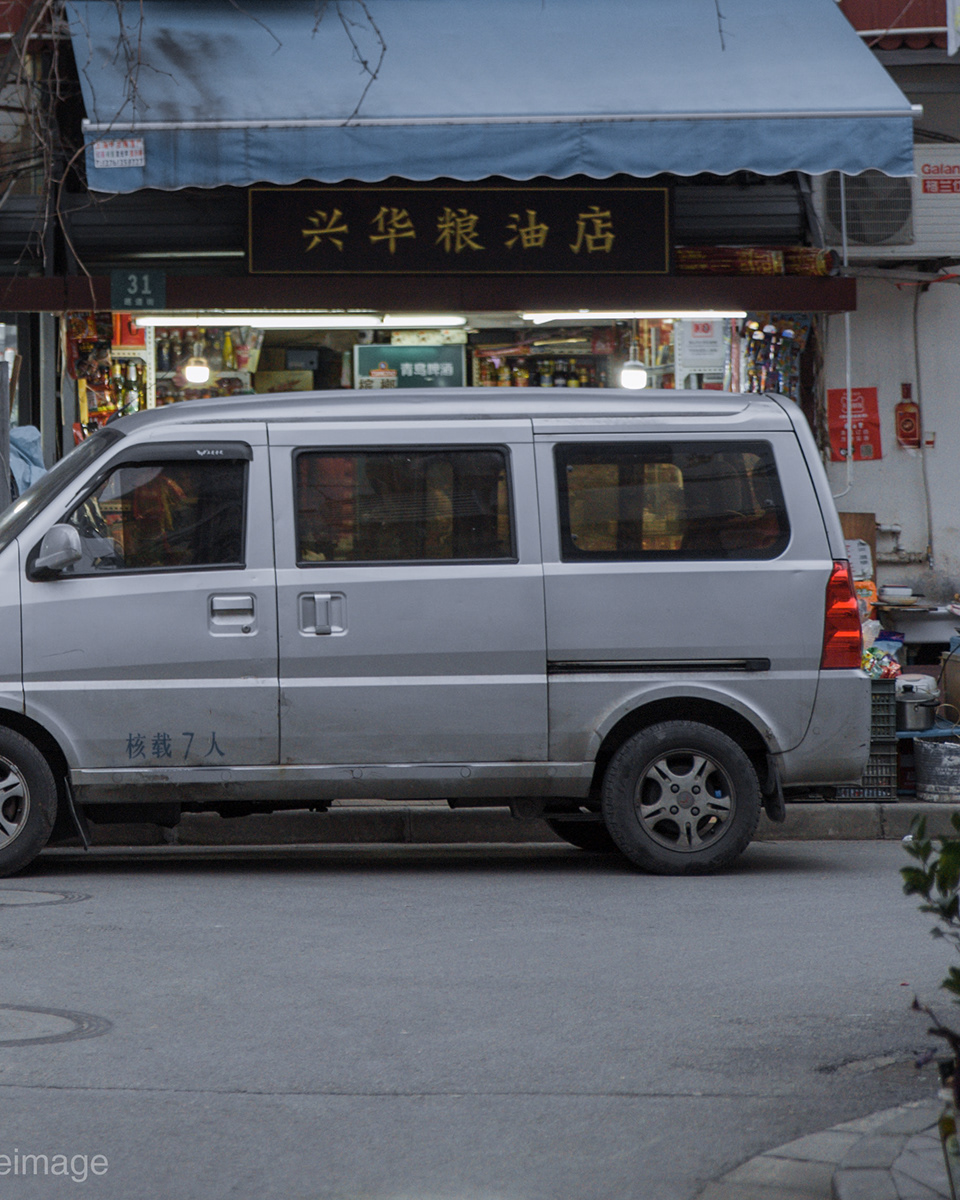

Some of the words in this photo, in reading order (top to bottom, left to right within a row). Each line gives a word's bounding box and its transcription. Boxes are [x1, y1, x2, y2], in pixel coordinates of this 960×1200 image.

[302, 205, 616, 254] 兴华粮油店
[127, 274, 152, 295] 31
[125, 731, 226, 760] 核载7人
